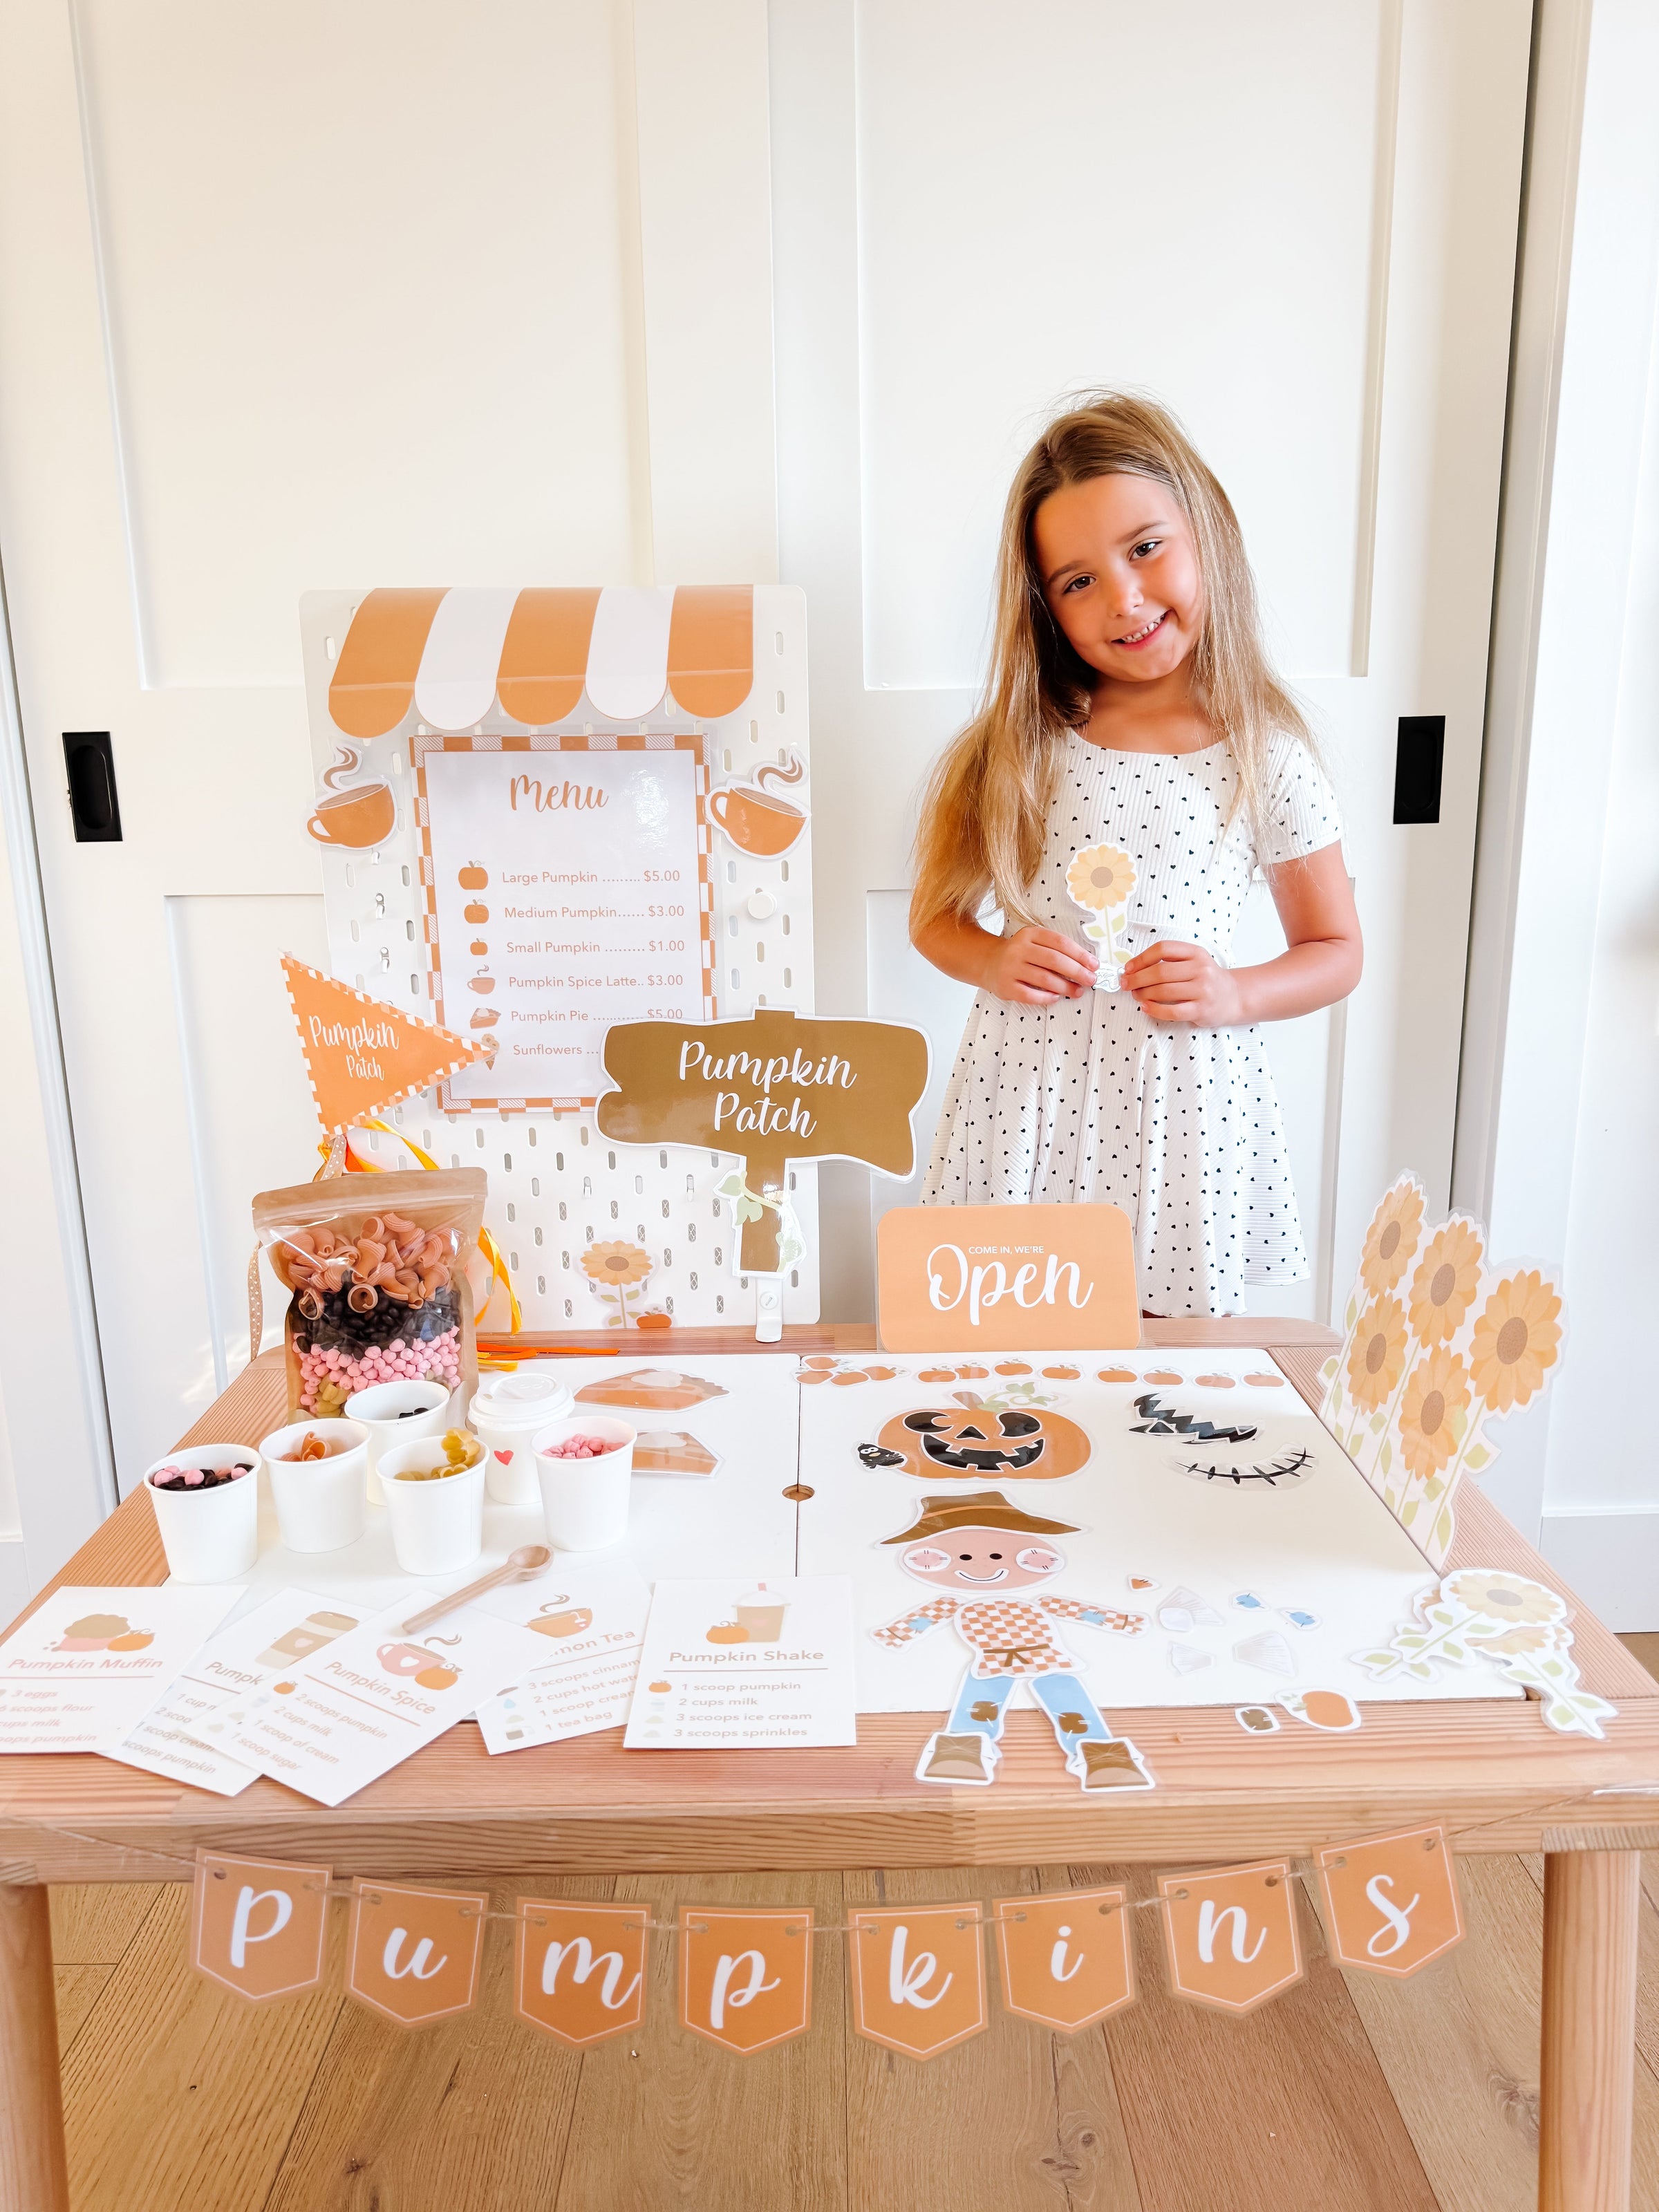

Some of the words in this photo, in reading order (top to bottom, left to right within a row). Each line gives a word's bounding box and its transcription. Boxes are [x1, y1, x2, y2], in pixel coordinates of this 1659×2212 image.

[510, 774, 609, 812] Menu
[502, 872, 538, 885] Large
[542, 871, 598, 885] Pumpkin
[644, 870, 680, 882] $5.00
[504, 906, 558, 918] Medium
[561, 906, 617, 920] Pumpkin
[648, 906, 684, 917] $3.00
[507, 941, 541, 953] Small
[545, 941, 600, 955] Pumpkin
[649, 940, 684, 952] $1.00
[509, 975, 564, 990] Pumpkin
[568, 975, 602, 990] Spice
[647, 974, 683, 986] $3.00
[511, 1010, 566, 1024] Pumpkin
[570, 1010, 588, 1021] Pie
[309, 1015, 400, 1056] Pumpkin
[513, 1044, 582, 1056] Sunflowers
[346, 1054, 385, 1081] Patch
[679, 1040, 857, 1094] Pumpkin
[714, 1091, 817, 1138] Patch
[968, 1246, 997, 1255] COME
[1000, 1246, 1013, 1255] IN,
[1015, 1245, 1044, 1254] WE'RE
[927, 1244, 1094, 1326] Open
[600, 1631, 635, 1643] Tea
[7, 1658, 95, 1671] Pumpkin
[100, 1658, 164, 1669] Muffin
[670, 1651, 757, 1665] Pumpkin
[763, 1650, 825, 1660] Shake
[205, 1661, 265, 1685] Pumpk
[541, 1671, 589, 1687] scoops
[11, 1689, 22, 1698] 3
[24, 1691, 58, 1699] eggs
[324, 1660, 391, 1695] Pumpkin
[391, 1690, 436, 1714] Spice
[547, 1689, 579, 1700] cups
[581, 1682, 606, 1692] hot
[693, 1684, 735, 1692] scoop
[740, 1682, 801, 1692] pumpkin
[10, 1705, 58, 1714] scoops
[61, 1703, 96, 1712] flour
[185, 1697, 207, 1709] cup
[553, 1700, 594, 1714] scoop
[692, 1699, 724, 1707] cups
[729, 1697, 758, 1705] milk
[155, 1706, 167, 1714] 2
[295, 1693, 308, 1702] 2
[304, 1698, 341, 1718] scoops
[339, 1714, 388, 1739] pumpkin
[31, 1718, 62, 1727] milk
[274, 1705, 286, 1714] 2
[283, 1711, 308, 1727] cups
[308, 1722, 333, 1737] milk
[558, 1719, 581, 1728] tea
[583, 1711, 613, 1723] bag
[676, 1713, 685, 1721] 3
[689, 1714, 740, 1723] scoops
[769, 1713, 812, 1721] cream
[32, 1734, 97, 1744] pumpkin
[142, 1725, 178, 1741] scoop
[180, 1736, 216, 1752] cream
[674, 1729, 683, 1737] 3
[687, 1730, 739, 1738] scoops
[742, 1728, 808, 1738] sprinkles
[261, 1723, 293, 1743] scoop
[293, 1738, 307, 1748] of
[306, 1745, 339, 1764] cream
[238, 1736, 271, 1756] scoop
[269, 1752, 303, 1771] sugar
[161, 1752, 217, 1774] pumpkin
